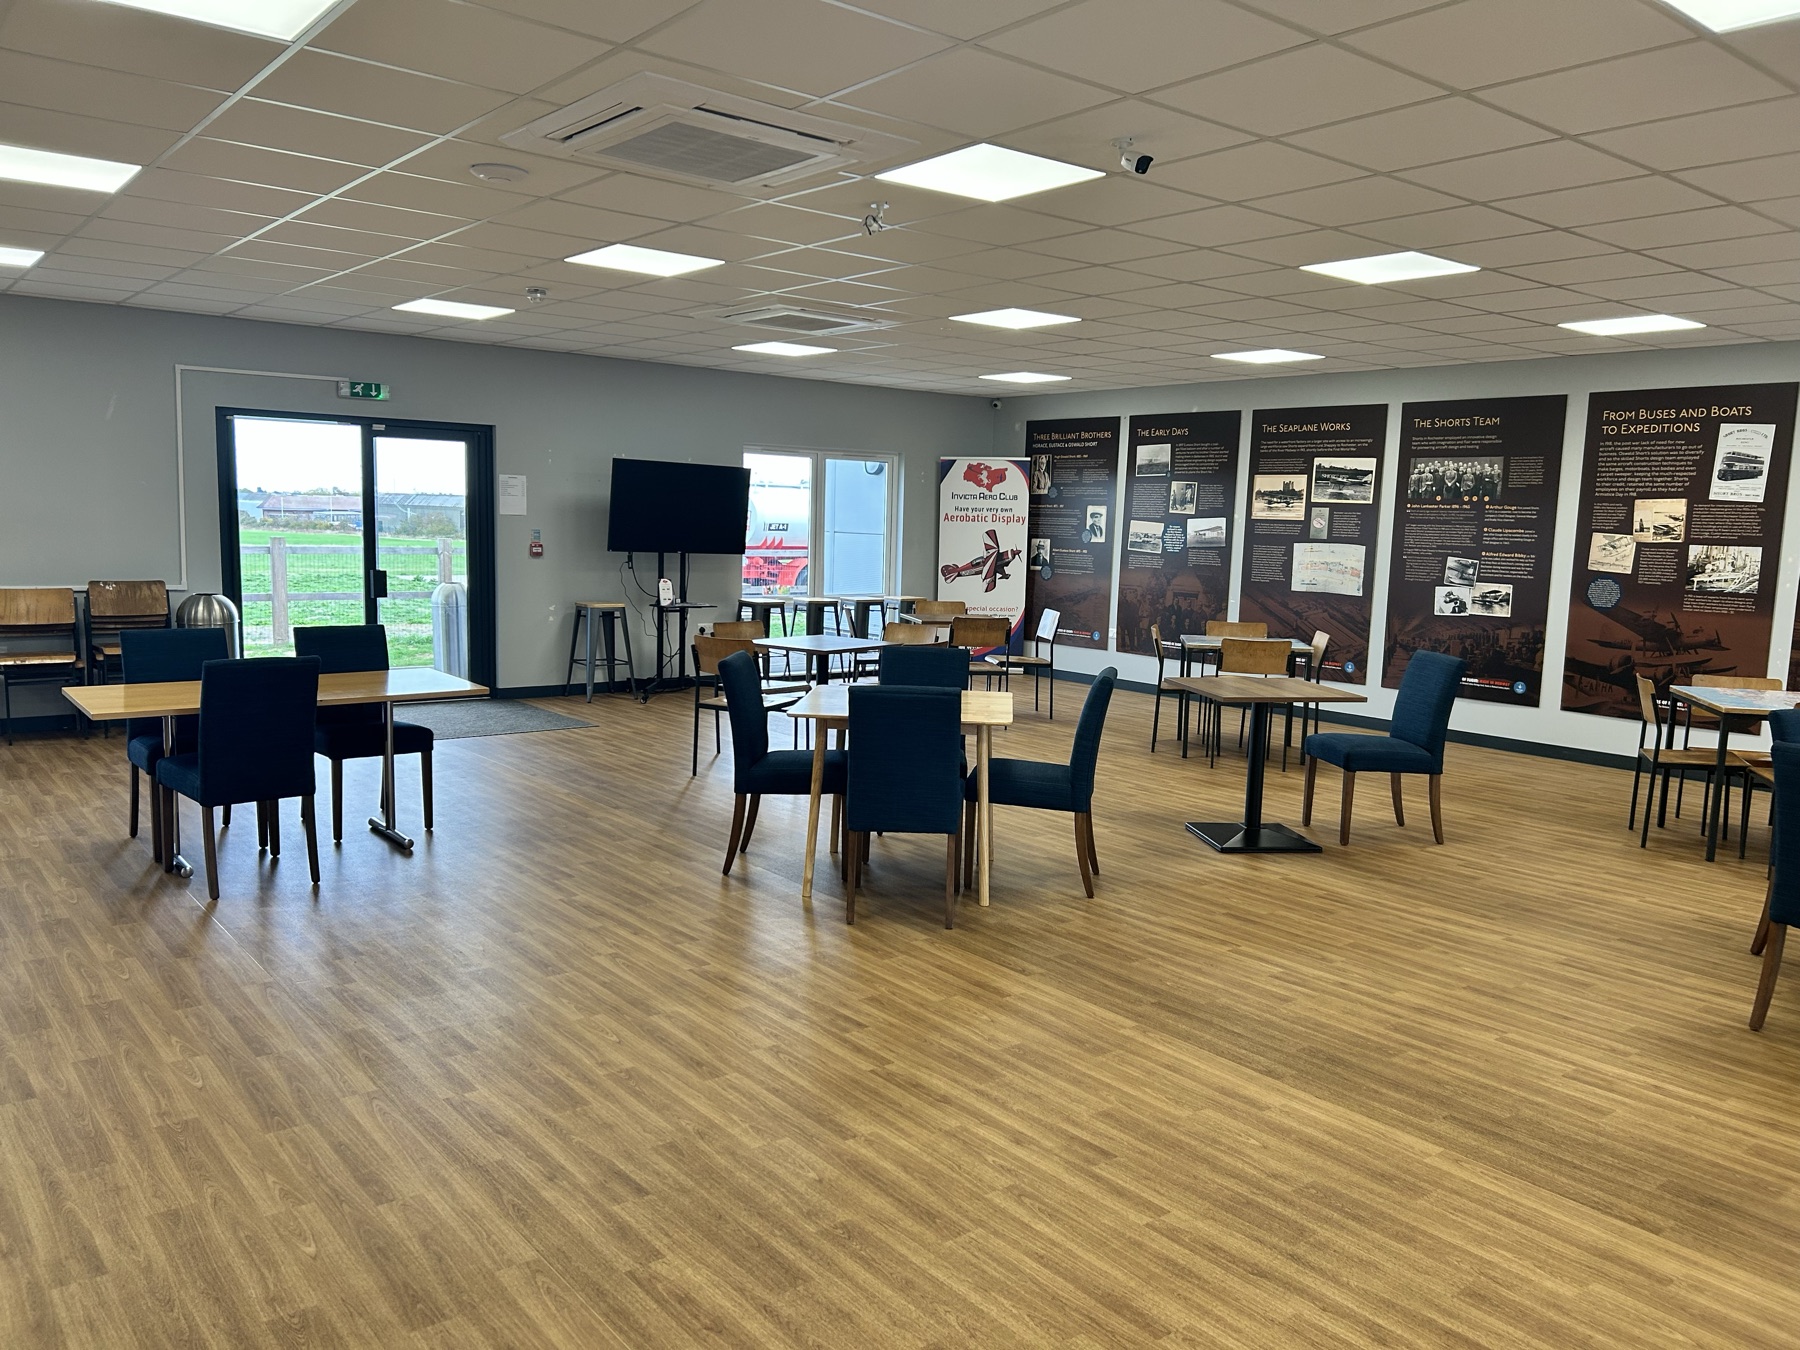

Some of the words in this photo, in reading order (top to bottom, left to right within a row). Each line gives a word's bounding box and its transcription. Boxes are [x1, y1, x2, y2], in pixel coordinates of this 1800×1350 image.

[1603, 410, 1635, 421] FROM
[1639, 409, 1676, 420] BUSES
[1679, 408, 1707, 418] AND
[1711, 406, 1752, 417] BOATS
[1262, 424, 1277, 433] THE
[1279, 423, 1318, 433] SEAPLANE
[1320, 422, 1351, 431] WORKS
[1414, 418, 1432, 428] THE
[1434, 418, 1471, 428] SHORTS
[1473, 416, 1500, 426] TEAM
[1137, 428, 1150, 437] THE
[1151, 428, 1170, 437] EARLY
[1172, 427, 1189, 436] DAYS
[1602, 425, 1617, 435] TO
[1621, 422, 1700, 435] EXPEDITIONS
[1051, 432, 1079, 441] BRILLIANT
[1081, 431, 1112, 439] BROTHERS
[951, 492, 977, 500] INVICTA
[978, 492, 997, 500] AERO
[999, 492, 1018, 501] CLUB
[943, 512, 988, 523] Aerobatic
[991, 513, 1026, 525] Display
